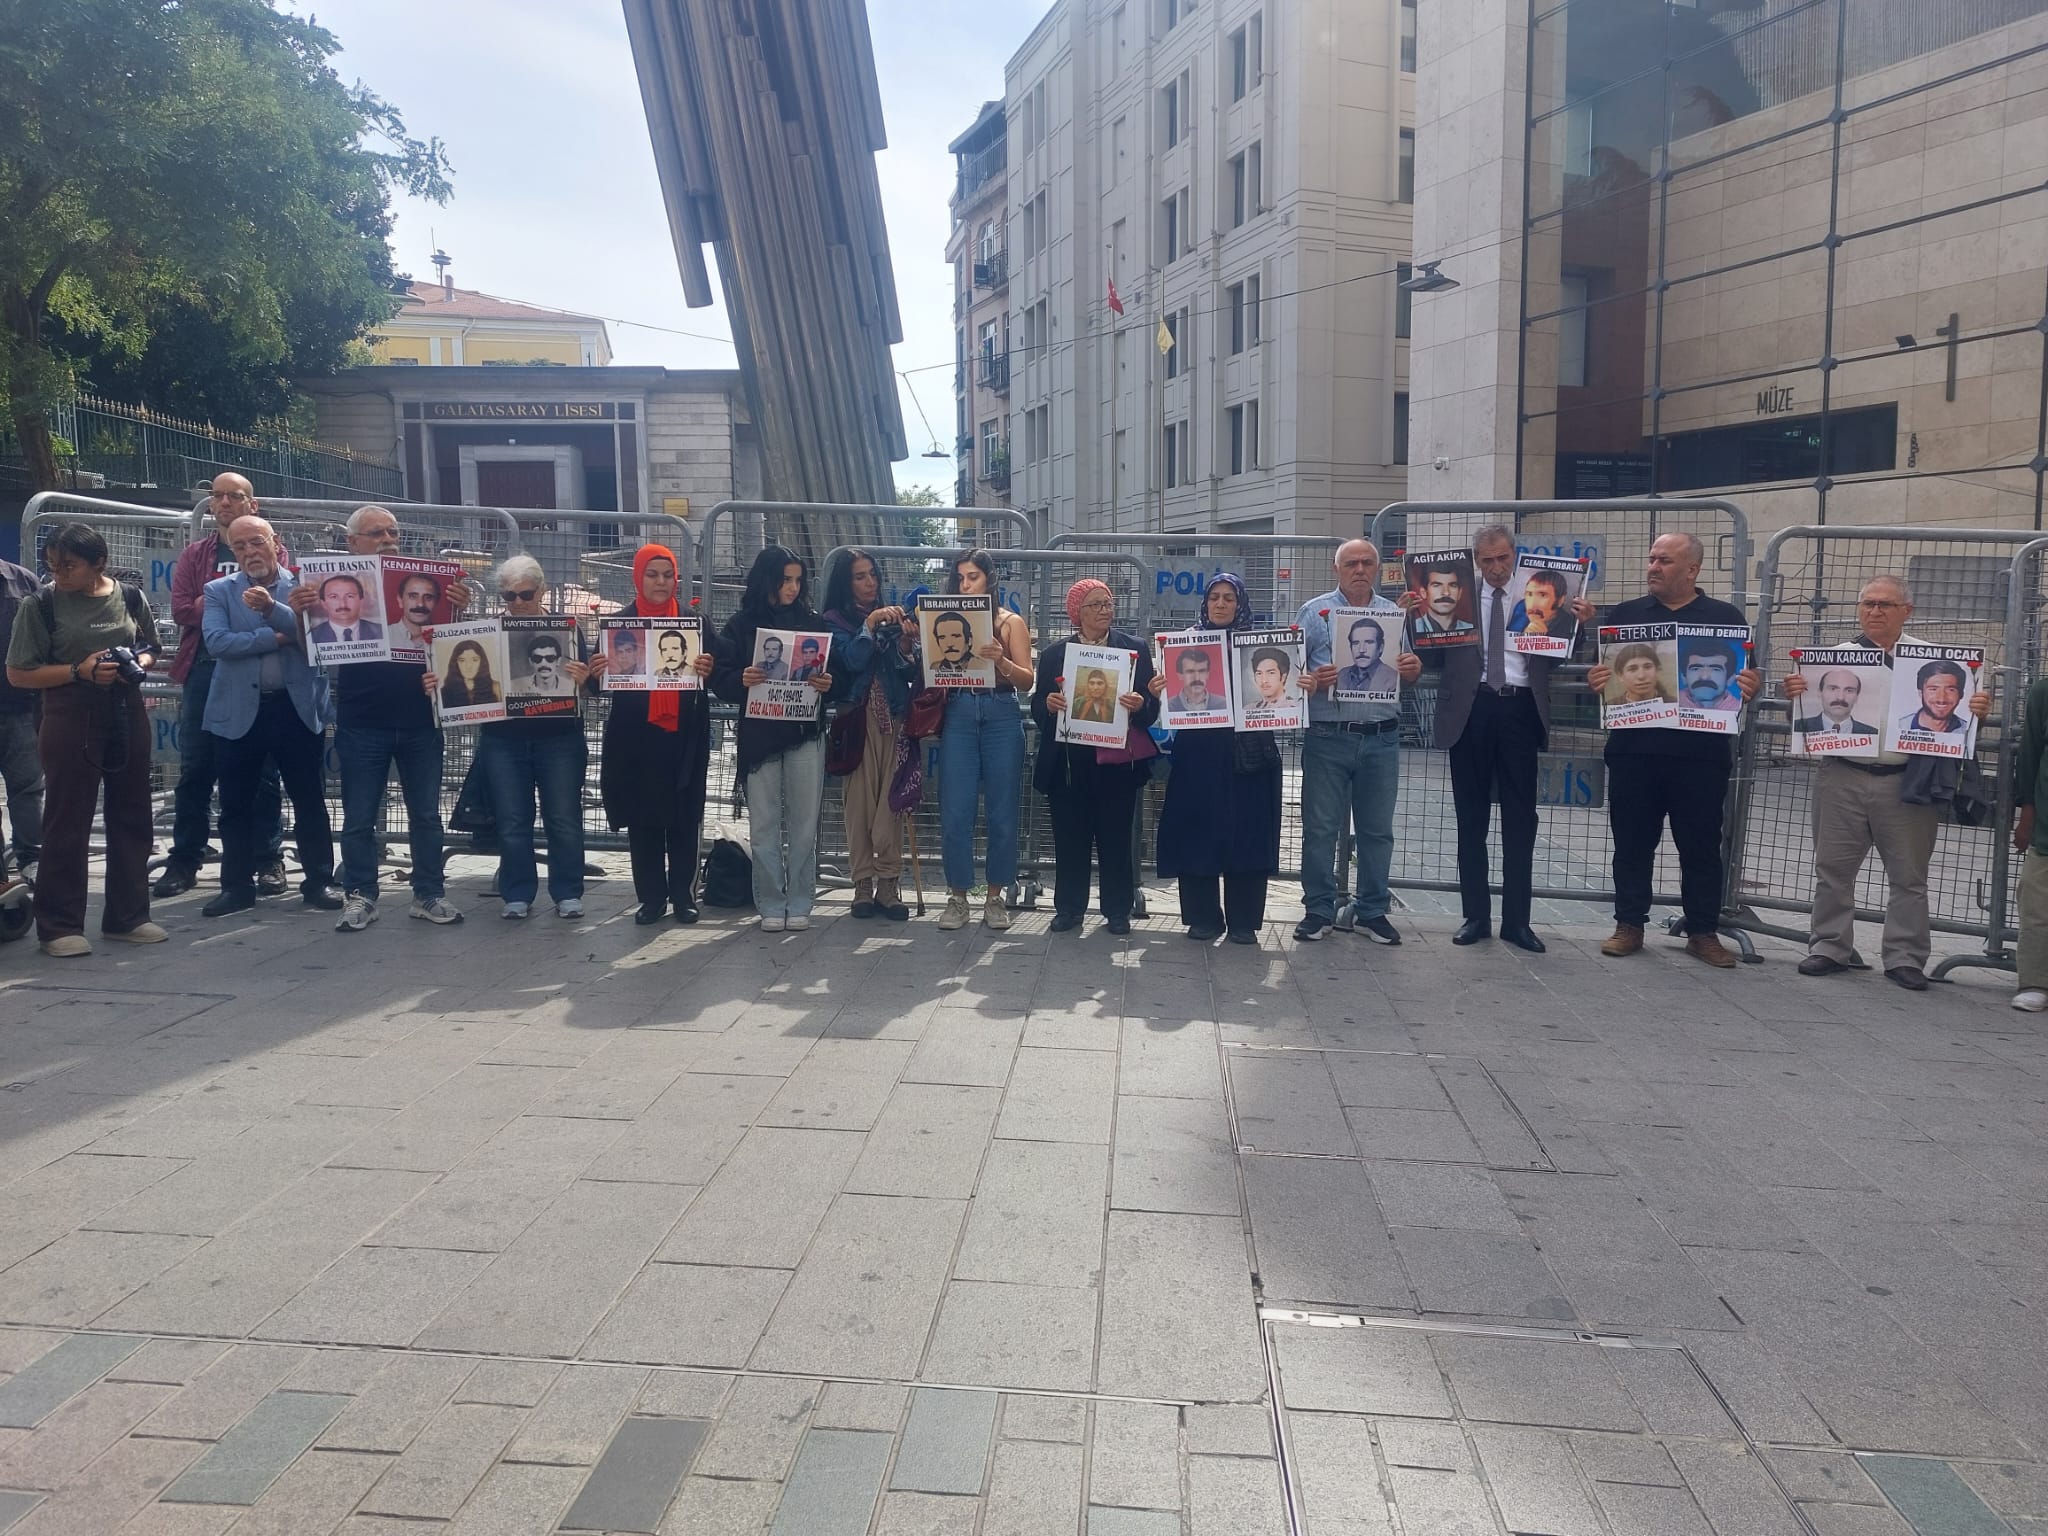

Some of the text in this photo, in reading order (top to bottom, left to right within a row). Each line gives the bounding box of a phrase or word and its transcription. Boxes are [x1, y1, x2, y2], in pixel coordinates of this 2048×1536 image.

[1757, 386, 1794, 415] MÜZE
[434, 402, 603, 417] GALATASARAY LİSESİ
[1413, 552, 1466, 564] AGİT AKİPA
[303, 559, 376, 573] MECİT BASKIN
[382, 560, 458, 574] KENAN BİLGİN
[1156, 567, 1221, 596] POL
[924, 599, 986, 610] İBRAHİM ÇELİK
[504, 619, 548, 628] HAYRETTİN
[625, 620, 645, 629] ÇELİK
[680, 620, 698, 629] ÇELİK
[432, 627, 470, 638] GÜLÜZAR
[1650, 625, 1672, 640] IŞIK
[1679, 627, 1747, 638] BRAHİM DEMİR
[1168, 634, 1221, 645] EHMİ TOSUN
[1234, 633, 1303, 646] MURAT YILDZ
[1517, 641, 1566, 651] KAYBEDİLDİ
[1079, 651, 1105, 660] HATUN
[1836, 651, 1881, 666] KARAKOÇ
[1900, 646, 1980, 661] HASAN OCAK
[607, 681, 647, 689] KAYBEDİLDİ
[657, 681, 696, 689] KAYBEDİLDİ
[934, 676, 985, 686] KAYBEDİLDİ
[1368, 689, 1396, 700] ÇELİK
[508, 697, 553, 711] GÖZALTINDA
[1244, 716, 1299, 728] KAYBEDİLDİ
[1605, 707, 1678, 728] KAYBEDİLDİ
[1679, 712, 1705, 720] ZALTINDA
[1679, 718, 1727, 731] YBEDİLDİ
[1805, 735, 1872, 752] KAYBEDİLDİ
[1807, 735, 1838, 743] ÖZALTINDA
[1899, 734, 1936, 743] GÖZALTINDA
[1897, 741, 1962, 756] KAYBEDİLDİ
[1540, 762, 1592, 806] LİS
